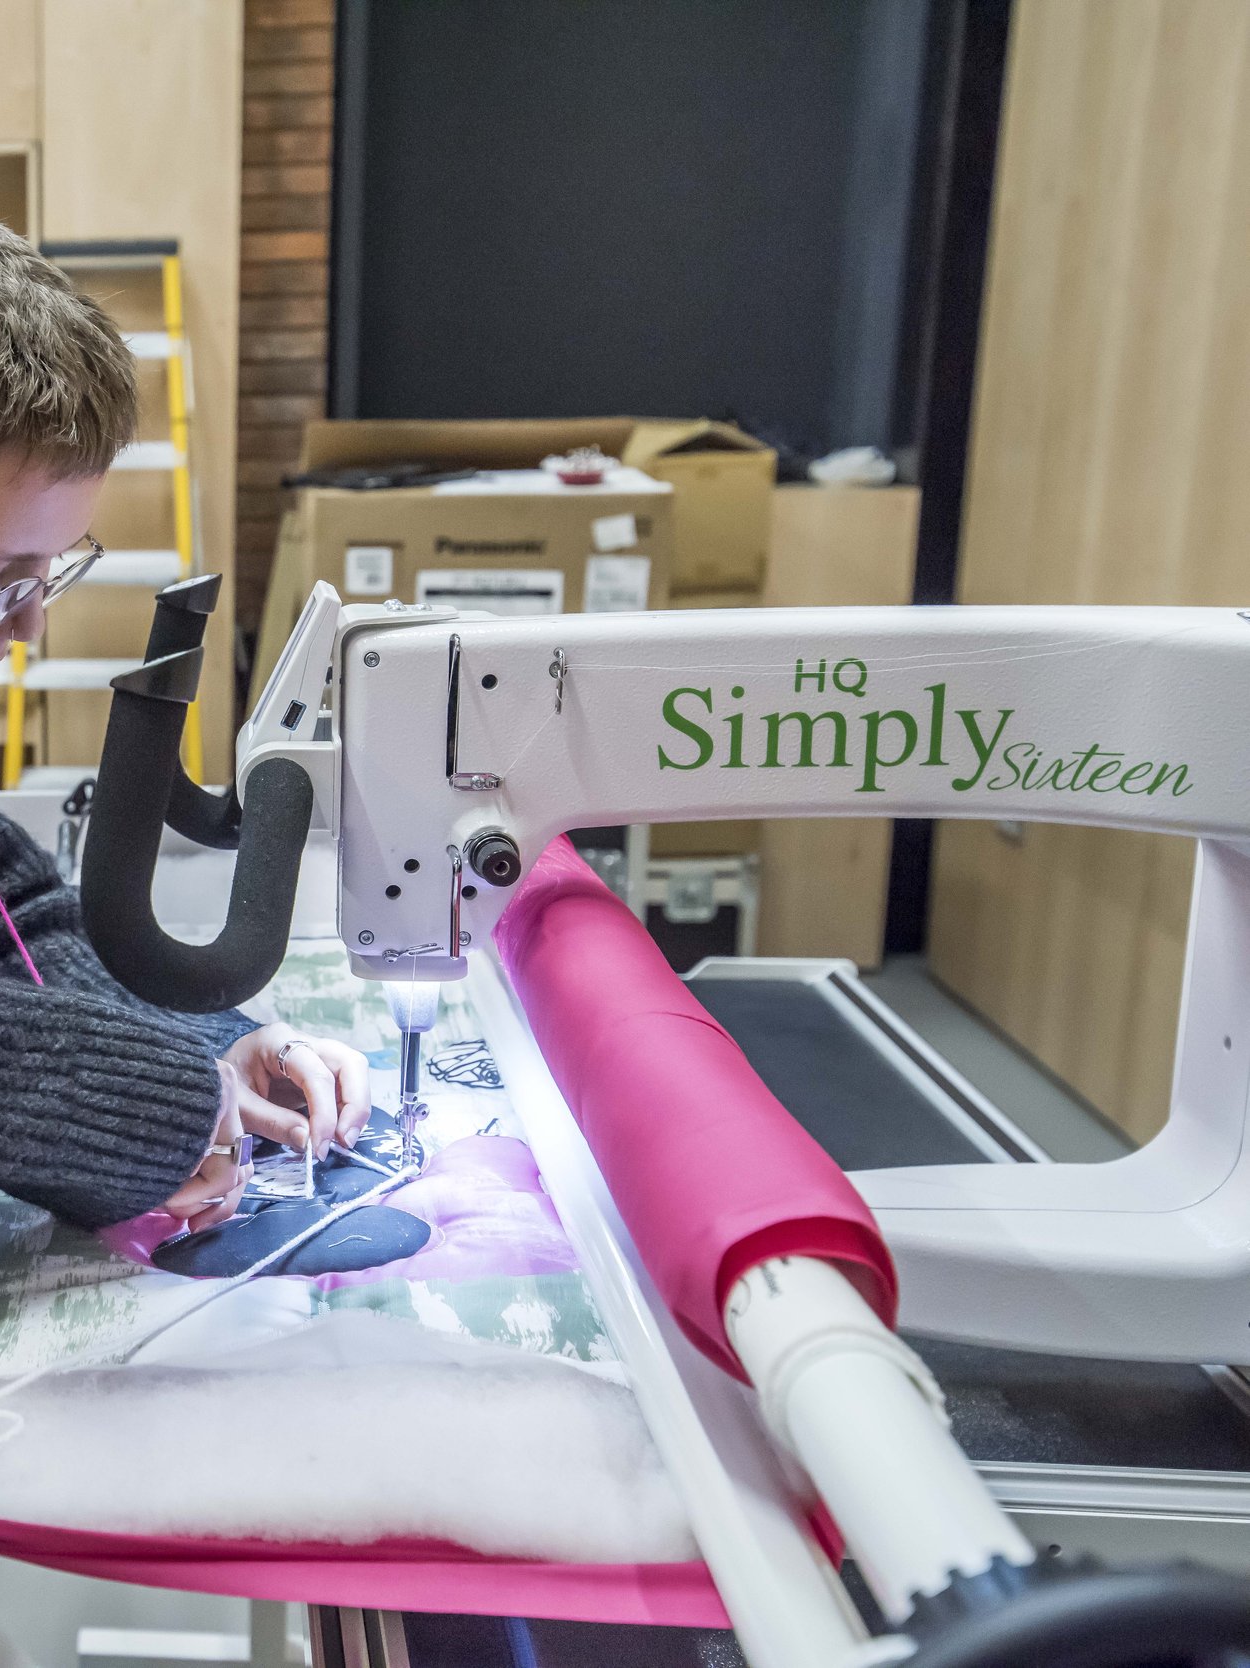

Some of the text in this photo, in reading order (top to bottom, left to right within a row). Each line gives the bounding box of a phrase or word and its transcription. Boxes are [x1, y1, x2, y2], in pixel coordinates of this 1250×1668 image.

[795, 657, 868, 697] HQ
[657, 683, 1193, 797] Simply Sixteen
